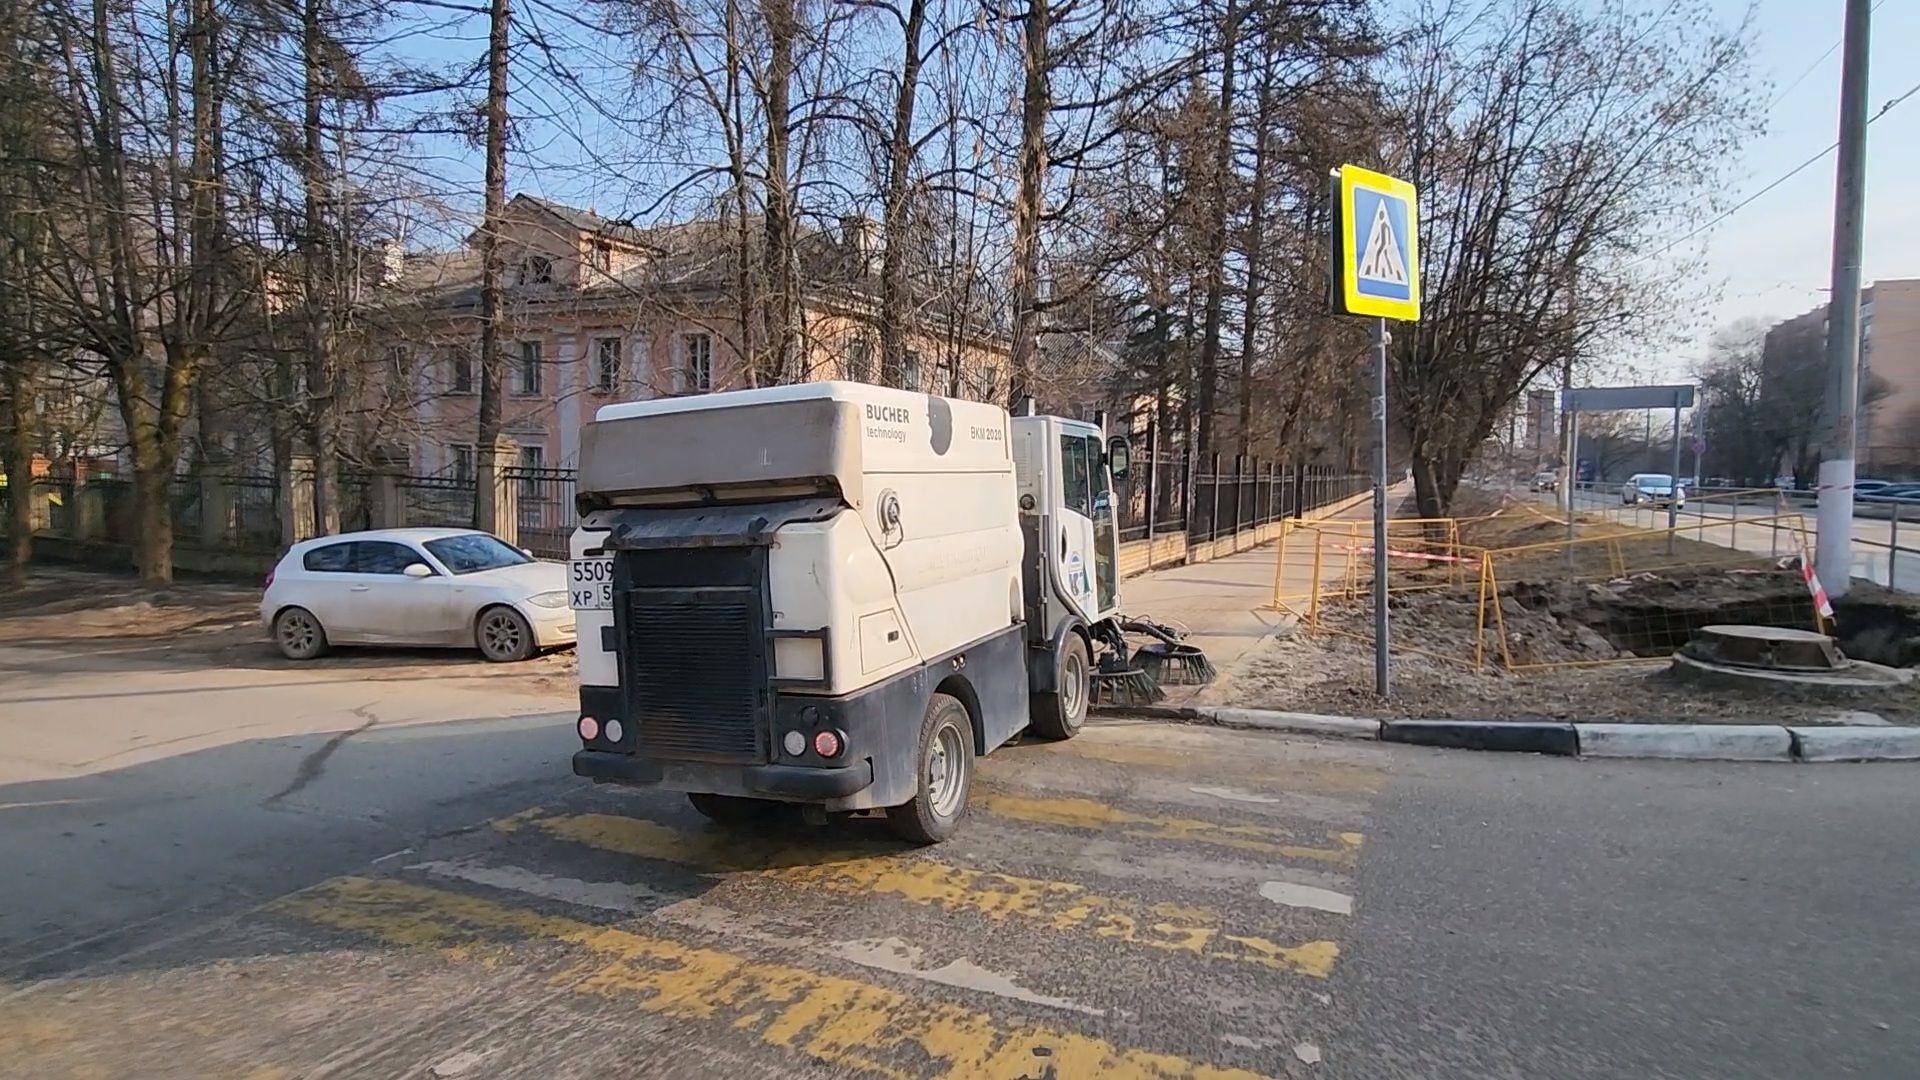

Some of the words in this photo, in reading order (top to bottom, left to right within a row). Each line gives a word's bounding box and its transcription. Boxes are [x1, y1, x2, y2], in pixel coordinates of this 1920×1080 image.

[866, 403, 910, 424] BUCHER
[866, 426, 906, 443] technology
[970, 426, 985, 441] BKM
[986, 428, 1002, 441] 2020
[573, 562, 614, 582] 5509
[572, 591, 593, 607] ХР
[603, 585, 612, 601] 5
